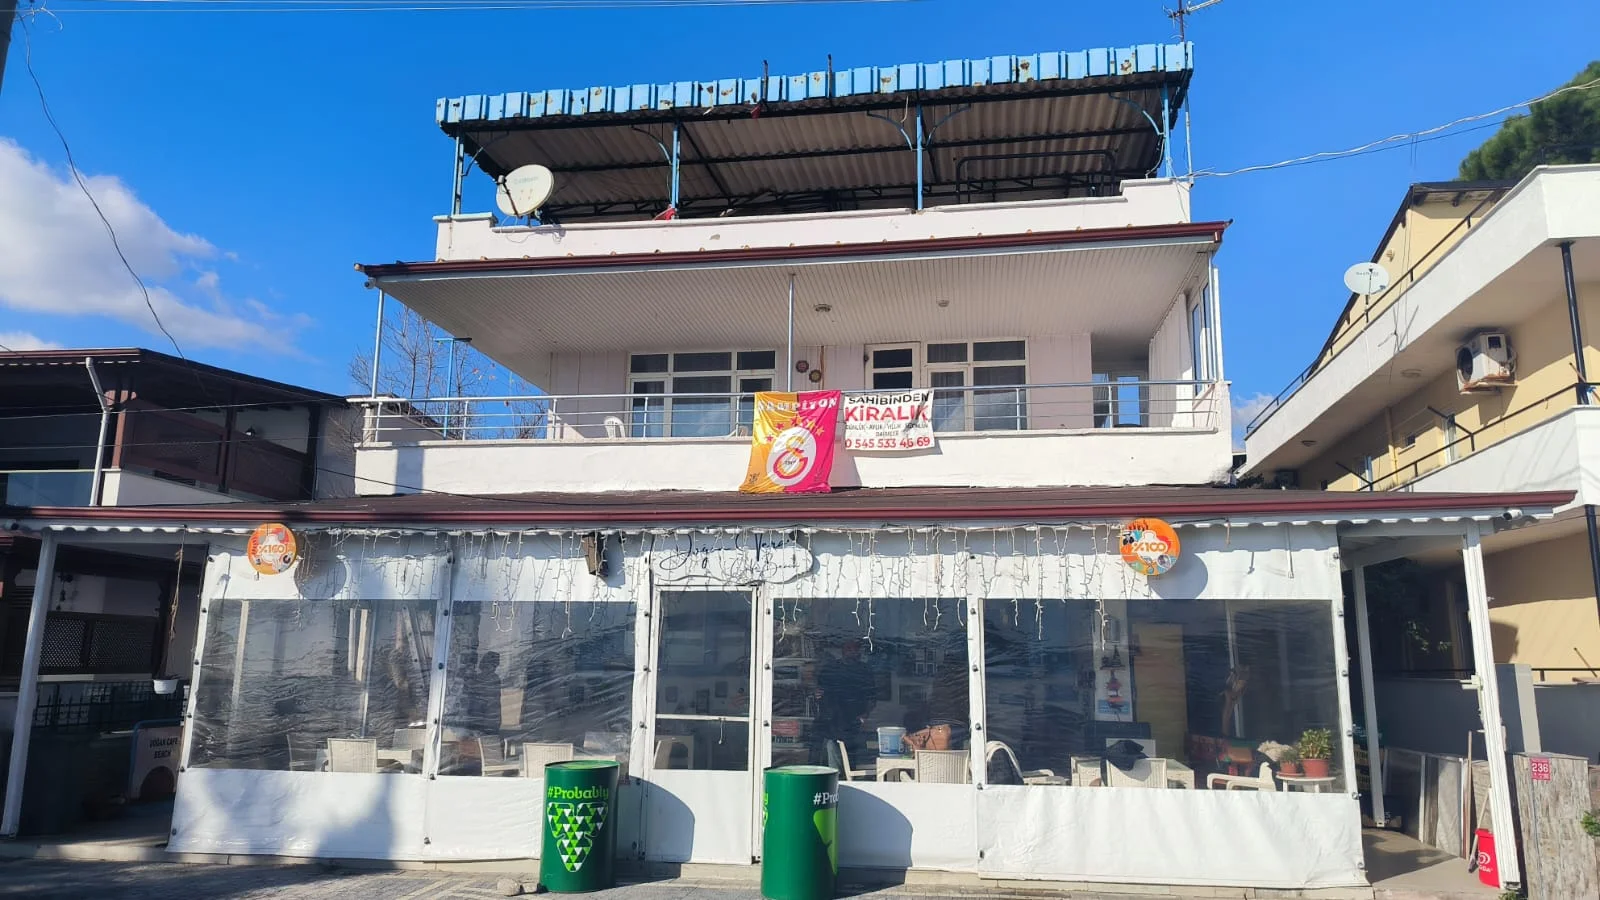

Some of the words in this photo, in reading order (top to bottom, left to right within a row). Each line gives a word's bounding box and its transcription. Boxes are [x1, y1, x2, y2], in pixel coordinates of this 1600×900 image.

[848, 392, 930, 406] SAHİBİNDEN
[844, 405, 930, 422] KİRALIK
[845, 439, 852, 448] 0
[855, 438, 875, 448] 545
[877, 438, 897, 448] 533
[916, 436, 931, 447] 69
[1132, 541, 1168, 553] %100
[1531, 762, 1549, 773] 236
[547, 785, 609, 800] #Probably
